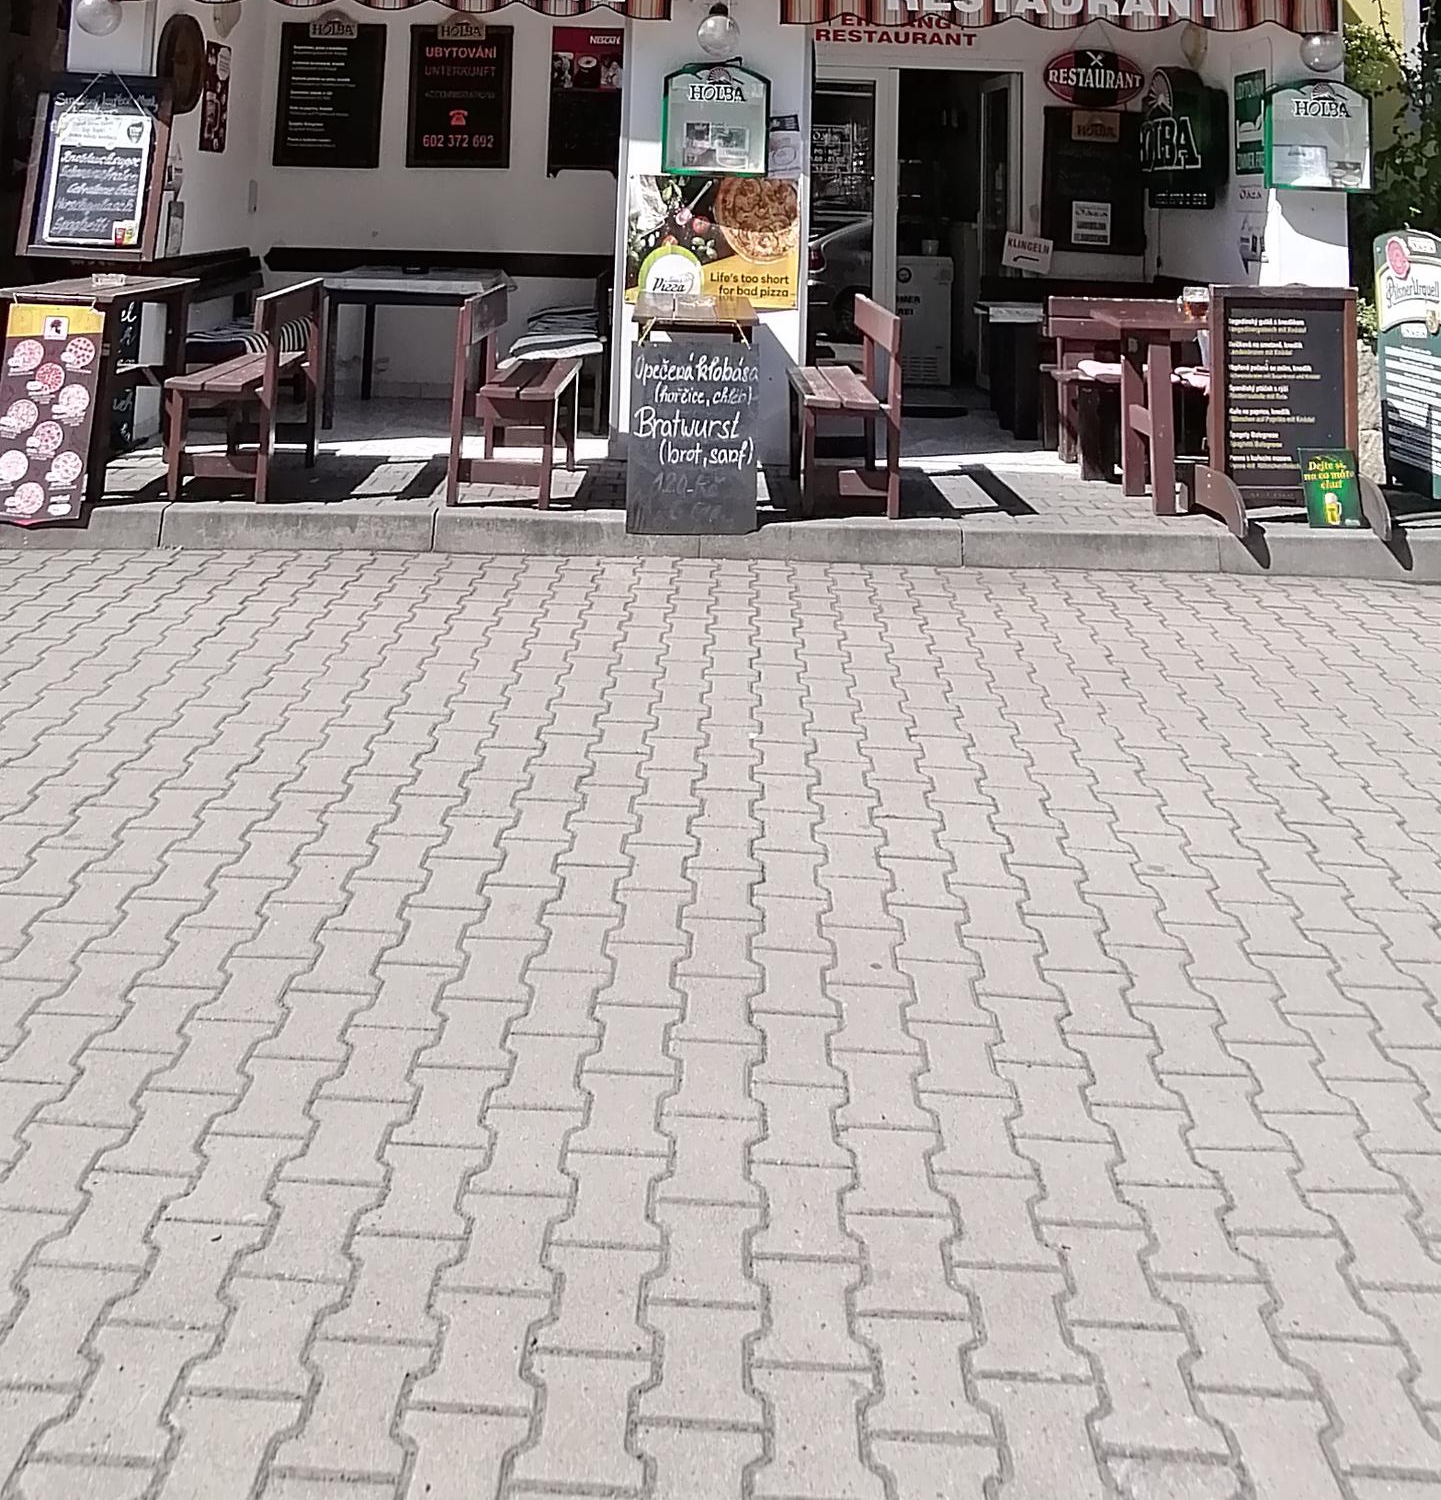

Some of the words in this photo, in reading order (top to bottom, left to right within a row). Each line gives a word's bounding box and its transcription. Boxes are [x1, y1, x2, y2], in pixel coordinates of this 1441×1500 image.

[815, 28, 977, 47] RESTAURANT
[425, 45, 497, 59] UBYTOVÁNÍ
[1048, 68, 1142, 89] RESTAURANT
[688, 83, 747, 103] HOLBA
[1294, 99, 1352, 118] HOLBA
[423, 134, 444, 148] 602
[447, 134, 469, 148] 372
[472, 134, 494, 149] 692
[652, 277, 686, 293] Pizza
[710, 272, 739, 283] Life's
[741, 274, 758, 284] too
[761, 274, 789, 285] short
[719, 285, 734, 296] for
[736, 286, 758, 296] bad
[760, 286, 789, 298] pizza
[634, 406, 740, 438] Bratwurst
[1309, 460, 1333, 472] Dejte
